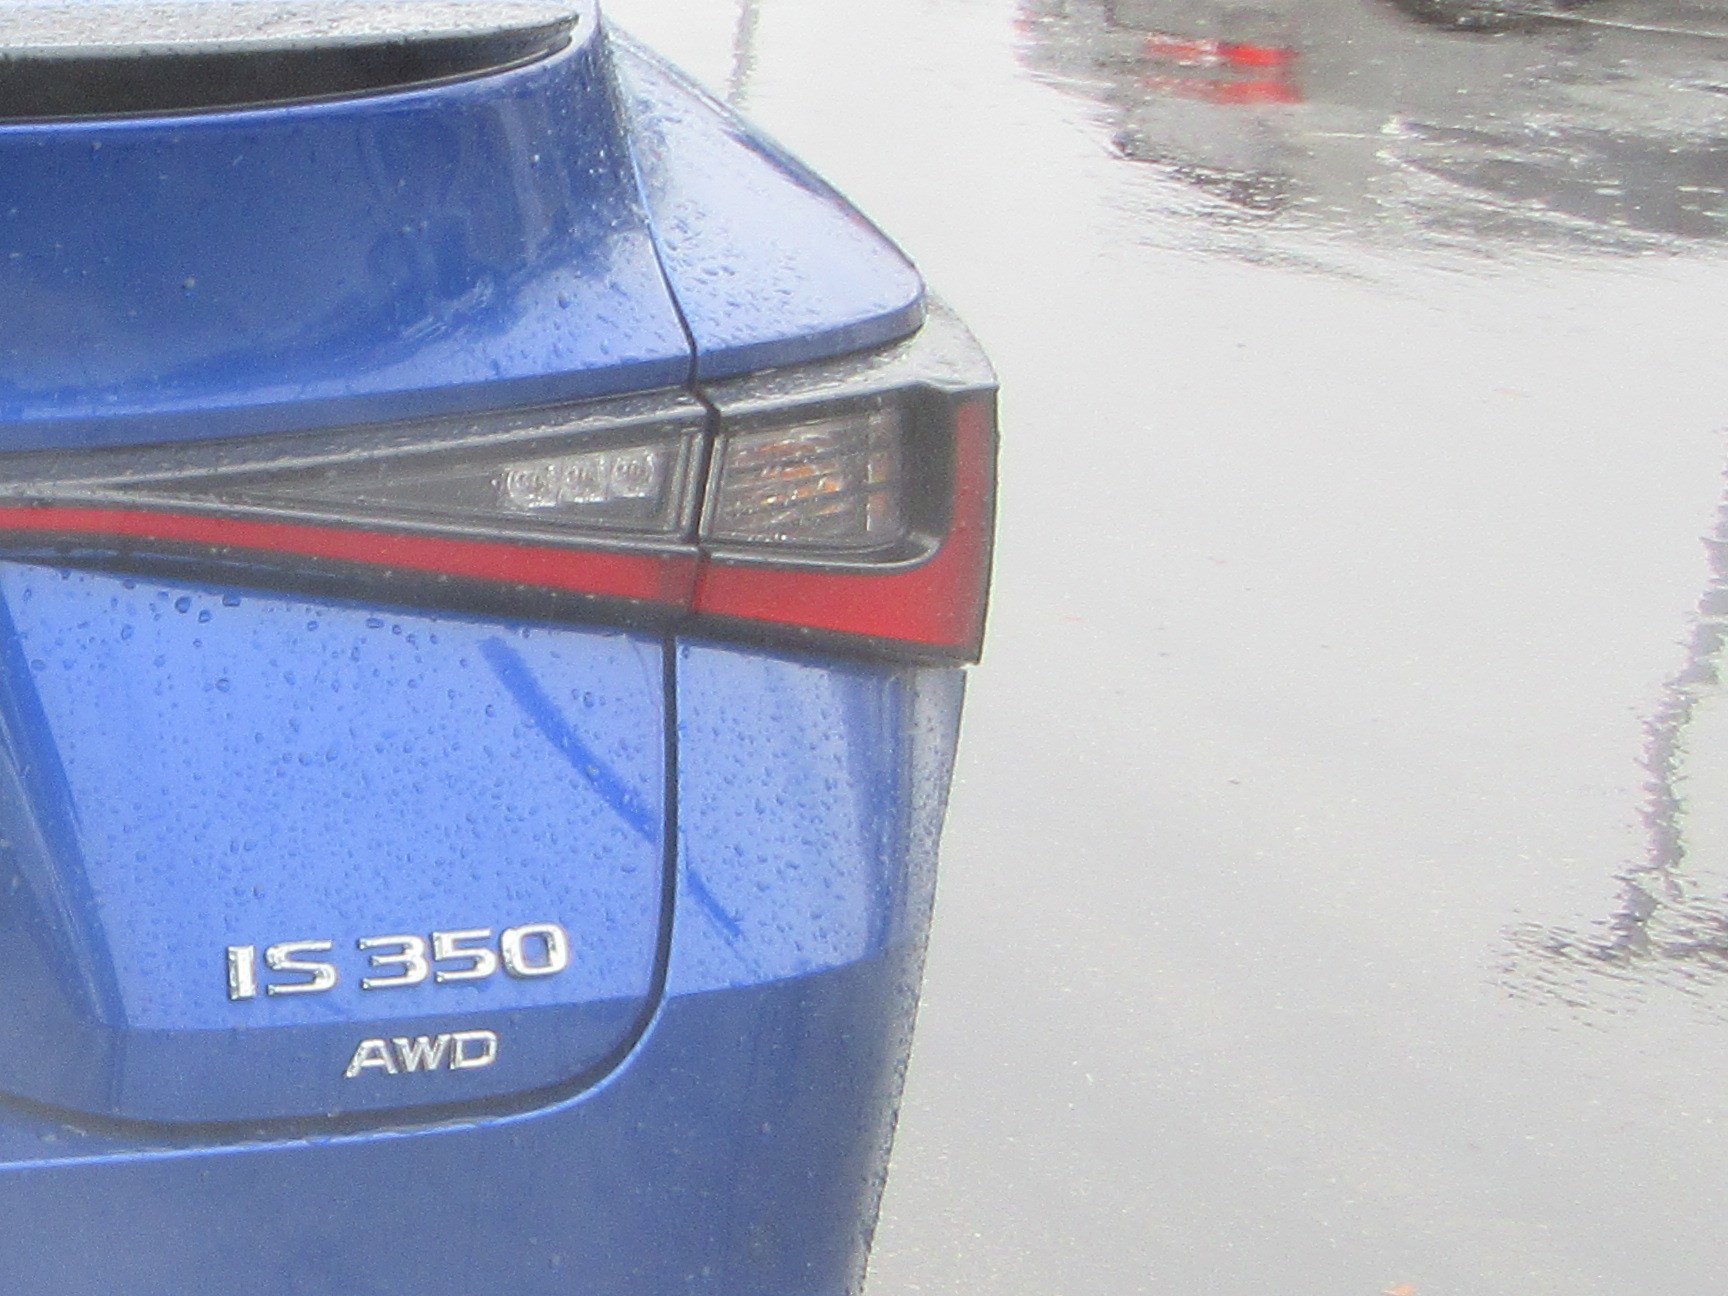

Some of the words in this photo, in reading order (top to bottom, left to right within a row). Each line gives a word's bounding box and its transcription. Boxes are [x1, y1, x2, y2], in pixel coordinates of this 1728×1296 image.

[227, 939, 339, 1002] IS
[358, 922, 571, 990] 350
[343, 1028, 501, 1079] AWD
